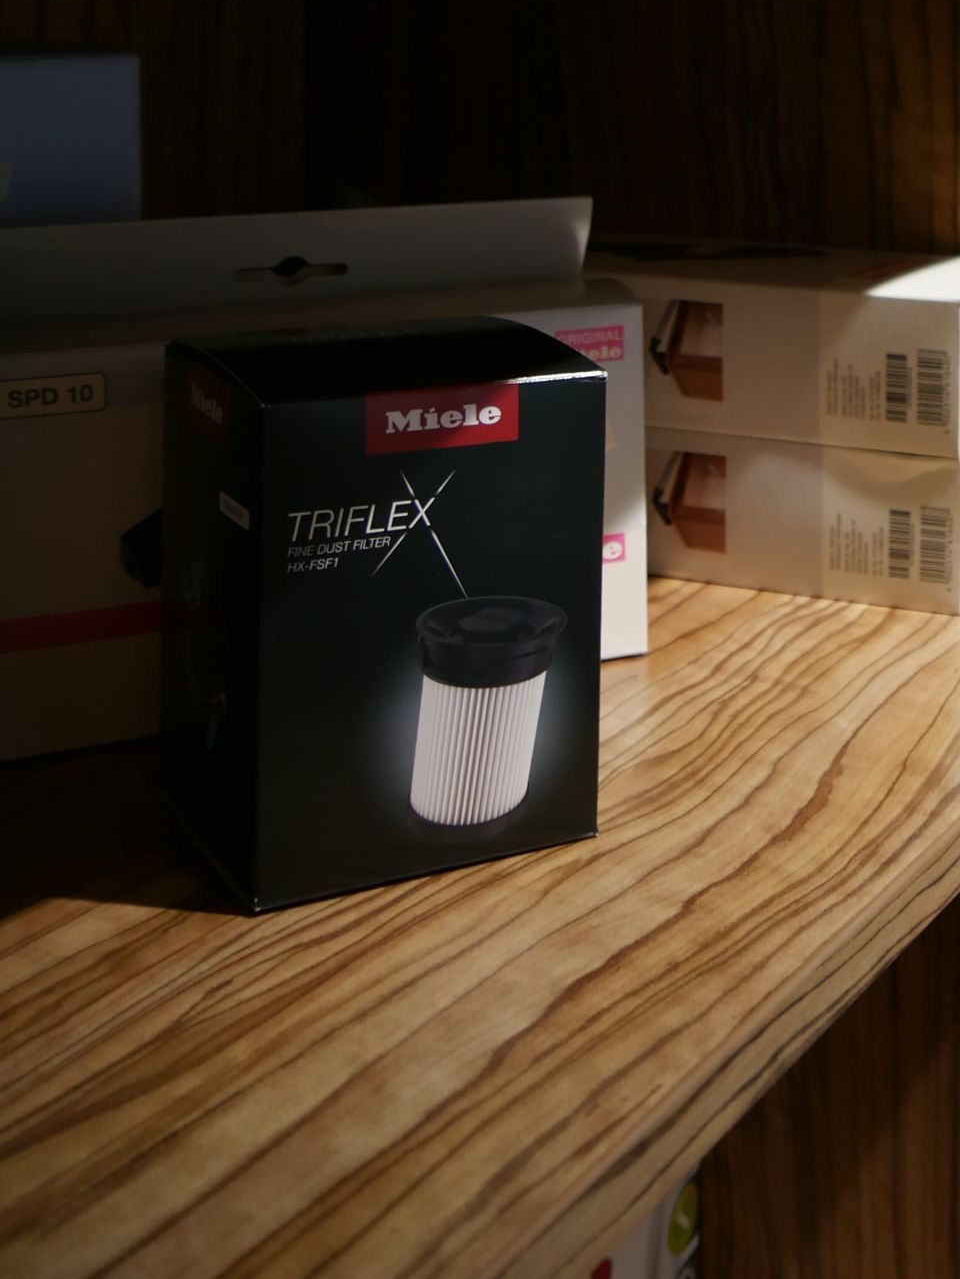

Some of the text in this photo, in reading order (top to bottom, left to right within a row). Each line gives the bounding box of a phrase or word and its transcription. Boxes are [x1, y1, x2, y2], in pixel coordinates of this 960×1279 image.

[8, 384, 93, 409] SPD 10
[385, 403, 502, 435] Miele
[287, 535, 392, 559] FINE DUST FILTER
[287, 556, 340, 574] HX-FSF1
